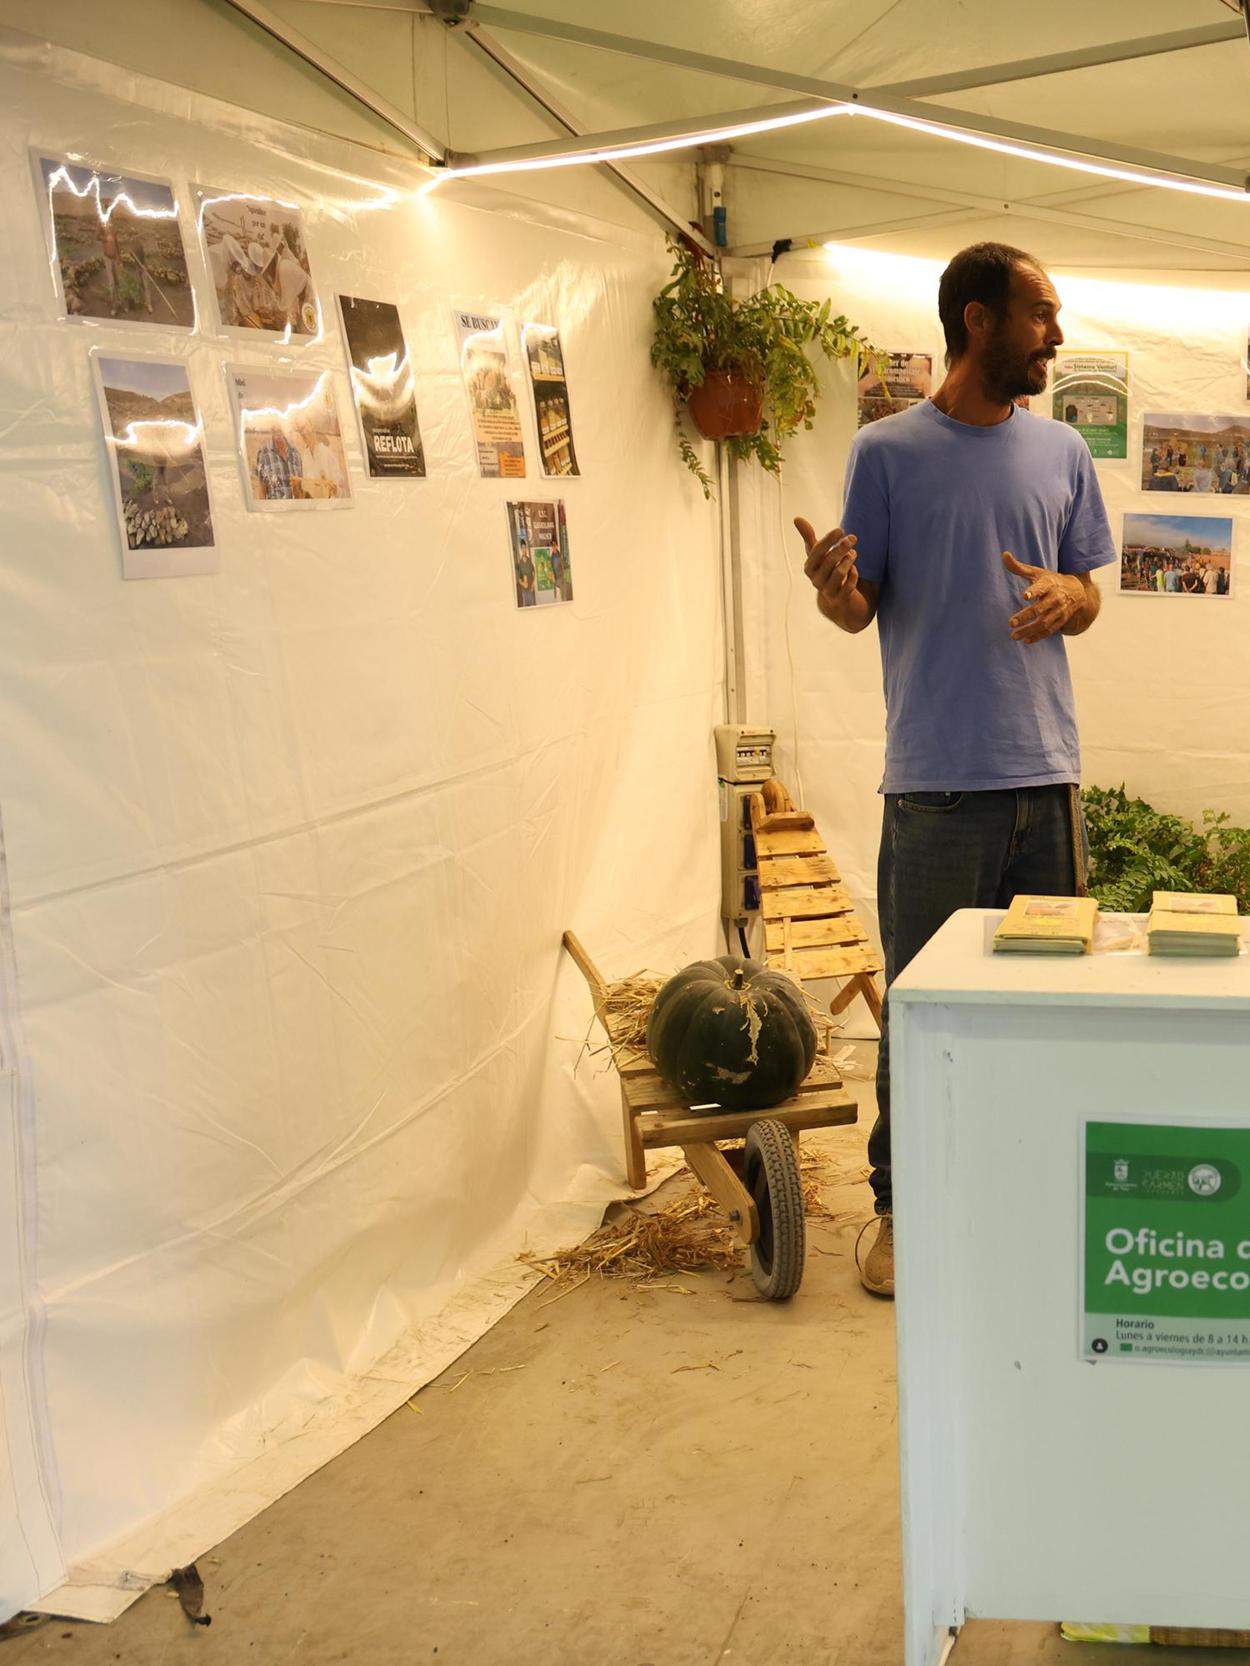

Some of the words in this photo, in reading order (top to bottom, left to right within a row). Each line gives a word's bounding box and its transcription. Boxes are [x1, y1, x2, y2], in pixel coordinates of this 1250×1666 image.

[373, 435, 415, 453] REFLOTA
[1105, 1227, 1225, 1259] Oficina
[1115, 1318, 1155, 1330] Horario
[1115, 1330, 1144, 1341] Lunes
[1147, 1333, 1153, 1341] a
[1155, 1332, 1191, 1343] viernes
[1193, 1333, 1206, 1344] de
[1208, 1334, 1214, 1344] 8
[1217, 1336, 1223, 1344] a
[1227, 1334, 1239, 1345] 14
